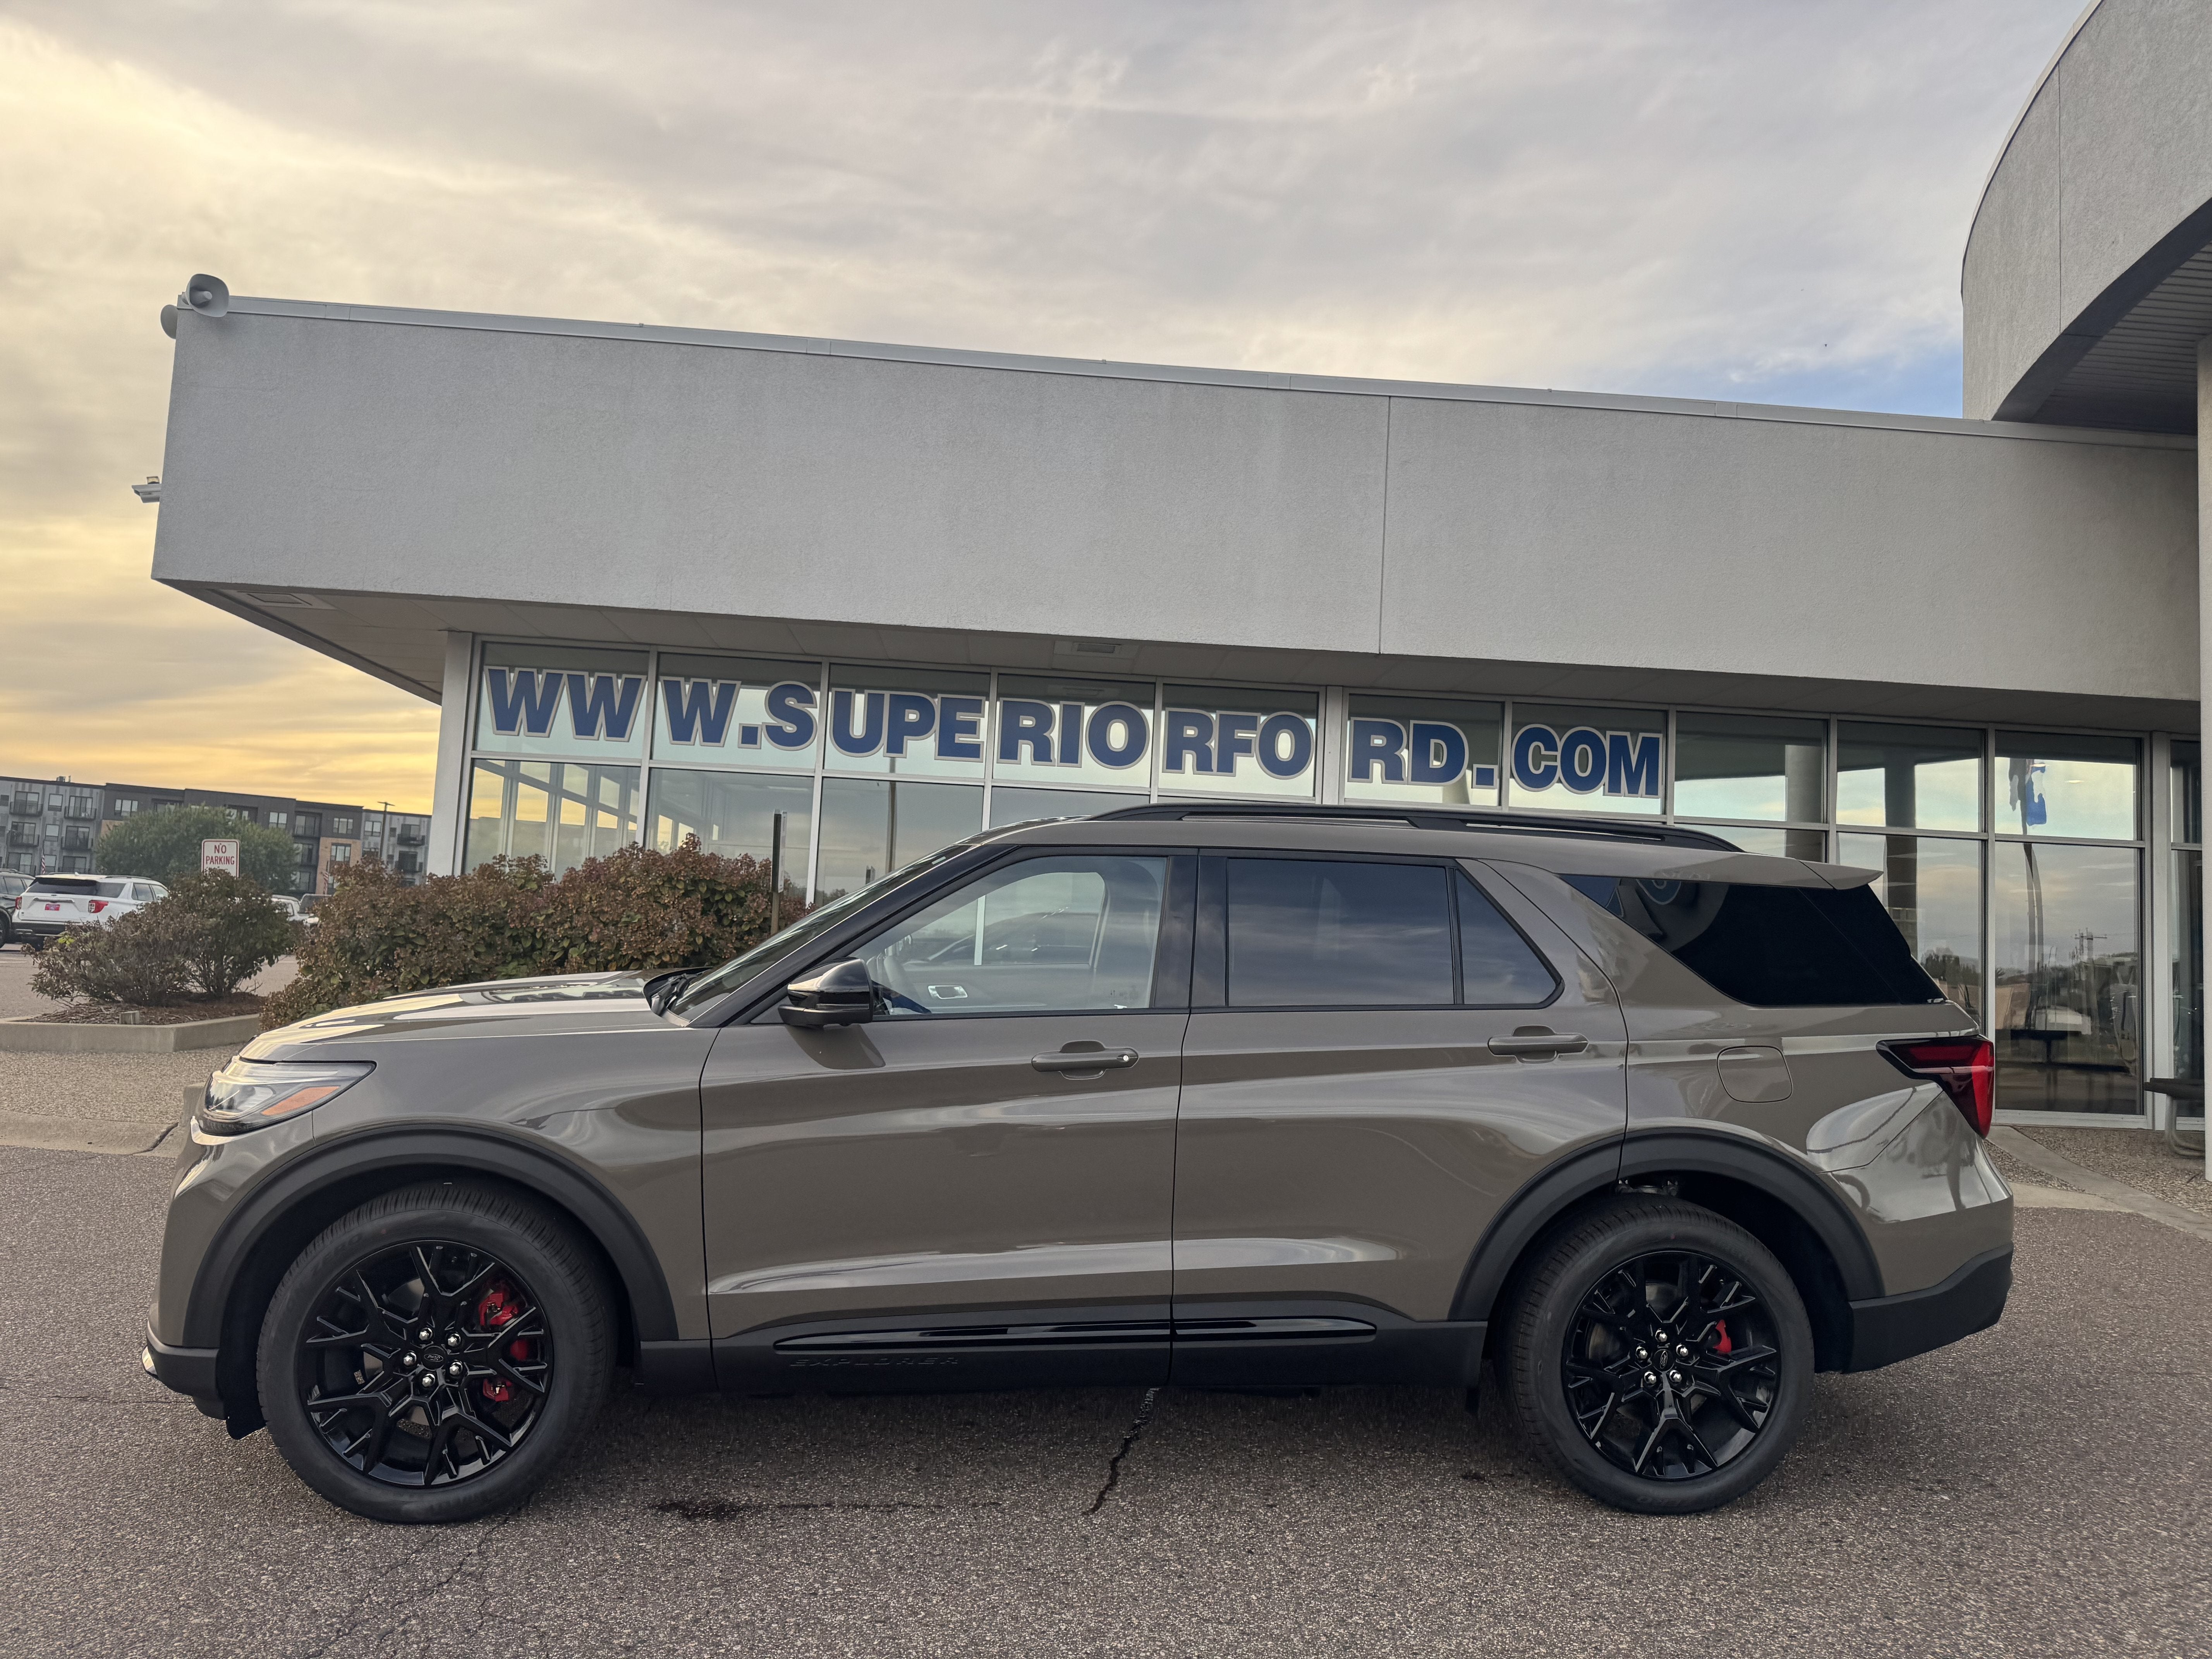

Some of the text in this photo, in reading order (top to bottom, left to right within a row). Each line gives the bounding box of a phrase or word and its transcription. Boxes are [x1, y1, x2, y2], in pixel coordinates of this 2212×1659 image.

[214, 844, 227, 854] NO
[206, 855, 235, 865] PARKING
[790, 1357, 959, 1367] EXPLORER
